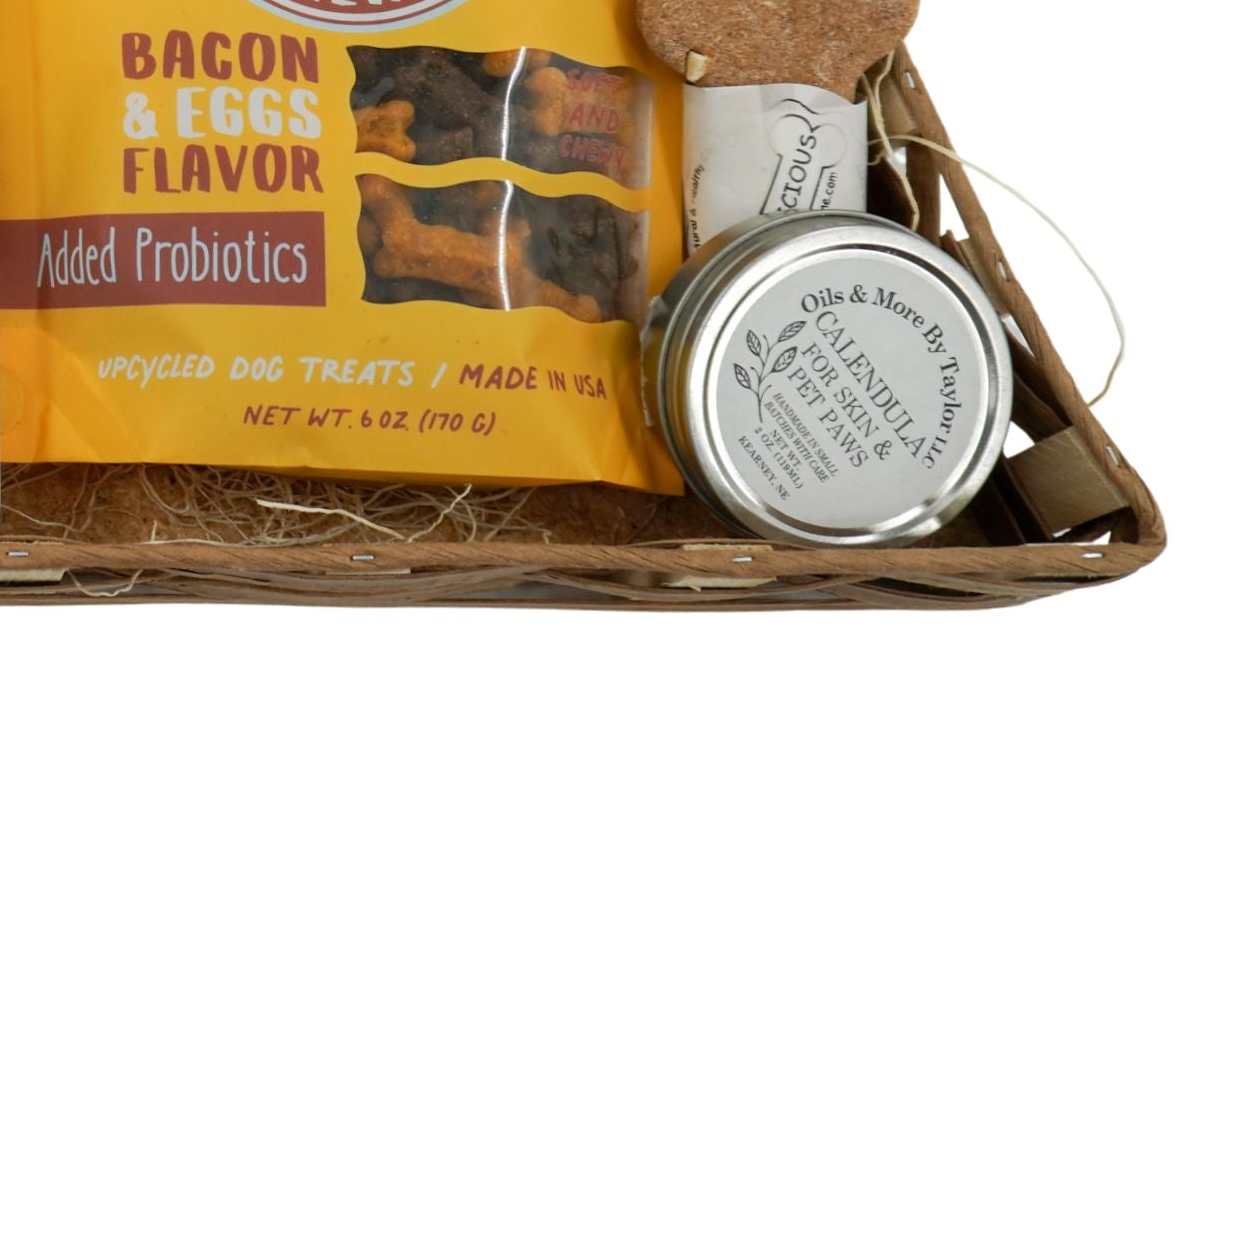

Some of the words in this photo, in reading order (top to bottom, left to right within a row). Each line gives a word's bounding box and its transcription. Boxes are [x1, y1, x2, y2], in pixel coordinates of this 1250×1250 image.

[121, 30, 319, 84] BACON
[122, 91, 159, 140] &
[176, 85, 323, 140] EGGS
[568, 103, 620, 132] AND
[123, 143, 325, 194] FLAVOR
[37, 226, 117, 288] Added
[136, 226, 308, 284] Probiotics
[800, 287, 845, 314] Oils
[850, 284, 868, 304] &
[871, 287, 926, 329] More
[922, 324, 948, 355] By
[97, 354, 216, 389] UPCYCLED
[229, 356, 284, 382] DOG
[299, 356, 415, 387] TREATS
[458, 363, 538, 391] MADE
[547, 370, 568, 392] IN
[574, 373, 608, 400] USA
[800, 342, 841, 388] FOR
[833, 386, 881, 439] SKIN
[873, 440, 893, 461] &
[815, 310, 928, 458] CALENDULA
[940, 356, 963, 434] Taylor
[243, 405, 301, 427] NET
[307, 408, 353, 431] WT.
[361, 410, 372, 428] 6
[471, 412, 498, 437] G)
[763, 400, 797, 440] BATCHES
[793, 437, 813, 461] WITH
[808, 459, 830, 484] CARE
[769, 429, 789, 451] NET
[772, 392, 813, 440] HANDMADE
[806, 437, 820, 450] IN
[814, 448, 839, 478] SMALL
[786, 367, 827, 408] PET
[817, 408, 870, 468] PAWS
[738, 435, 778, 486] KEARNEY,
[776, 484, 791, 501] NE
[921, 432, 948, 470] LLC
